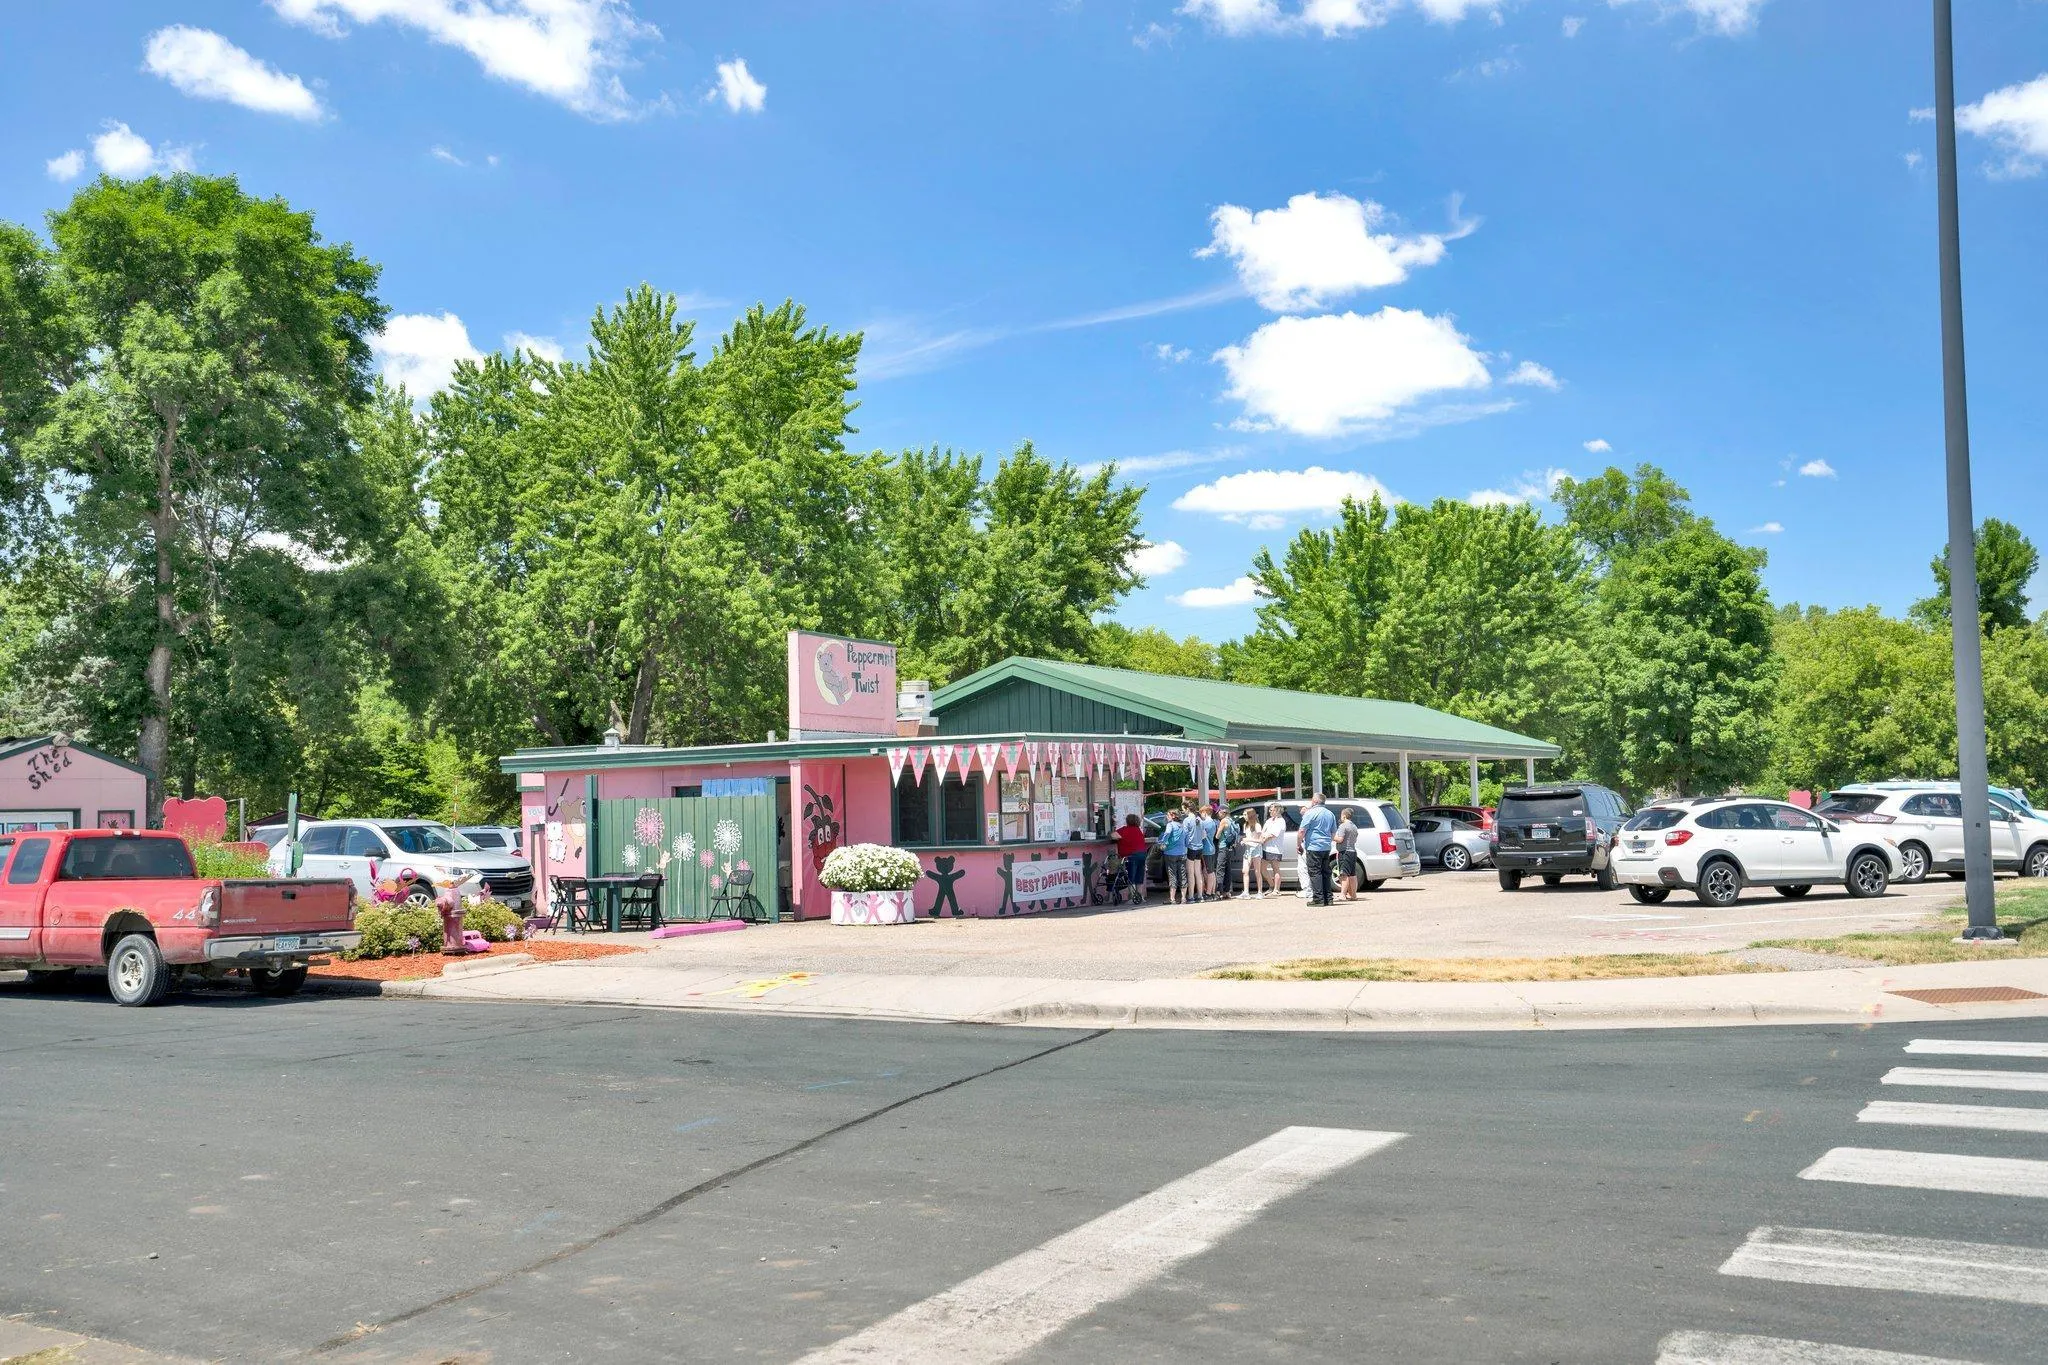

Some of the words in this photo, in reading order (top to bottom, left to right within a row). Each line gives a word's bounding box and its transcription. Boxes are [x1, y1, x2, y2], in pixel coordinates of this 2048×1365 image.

[851, 672, 879, 693] Twist
[27, 749, 60, 770] The
[28, 751, 72, 789] Shed
[1015, 877, 1040, 892] BEST
